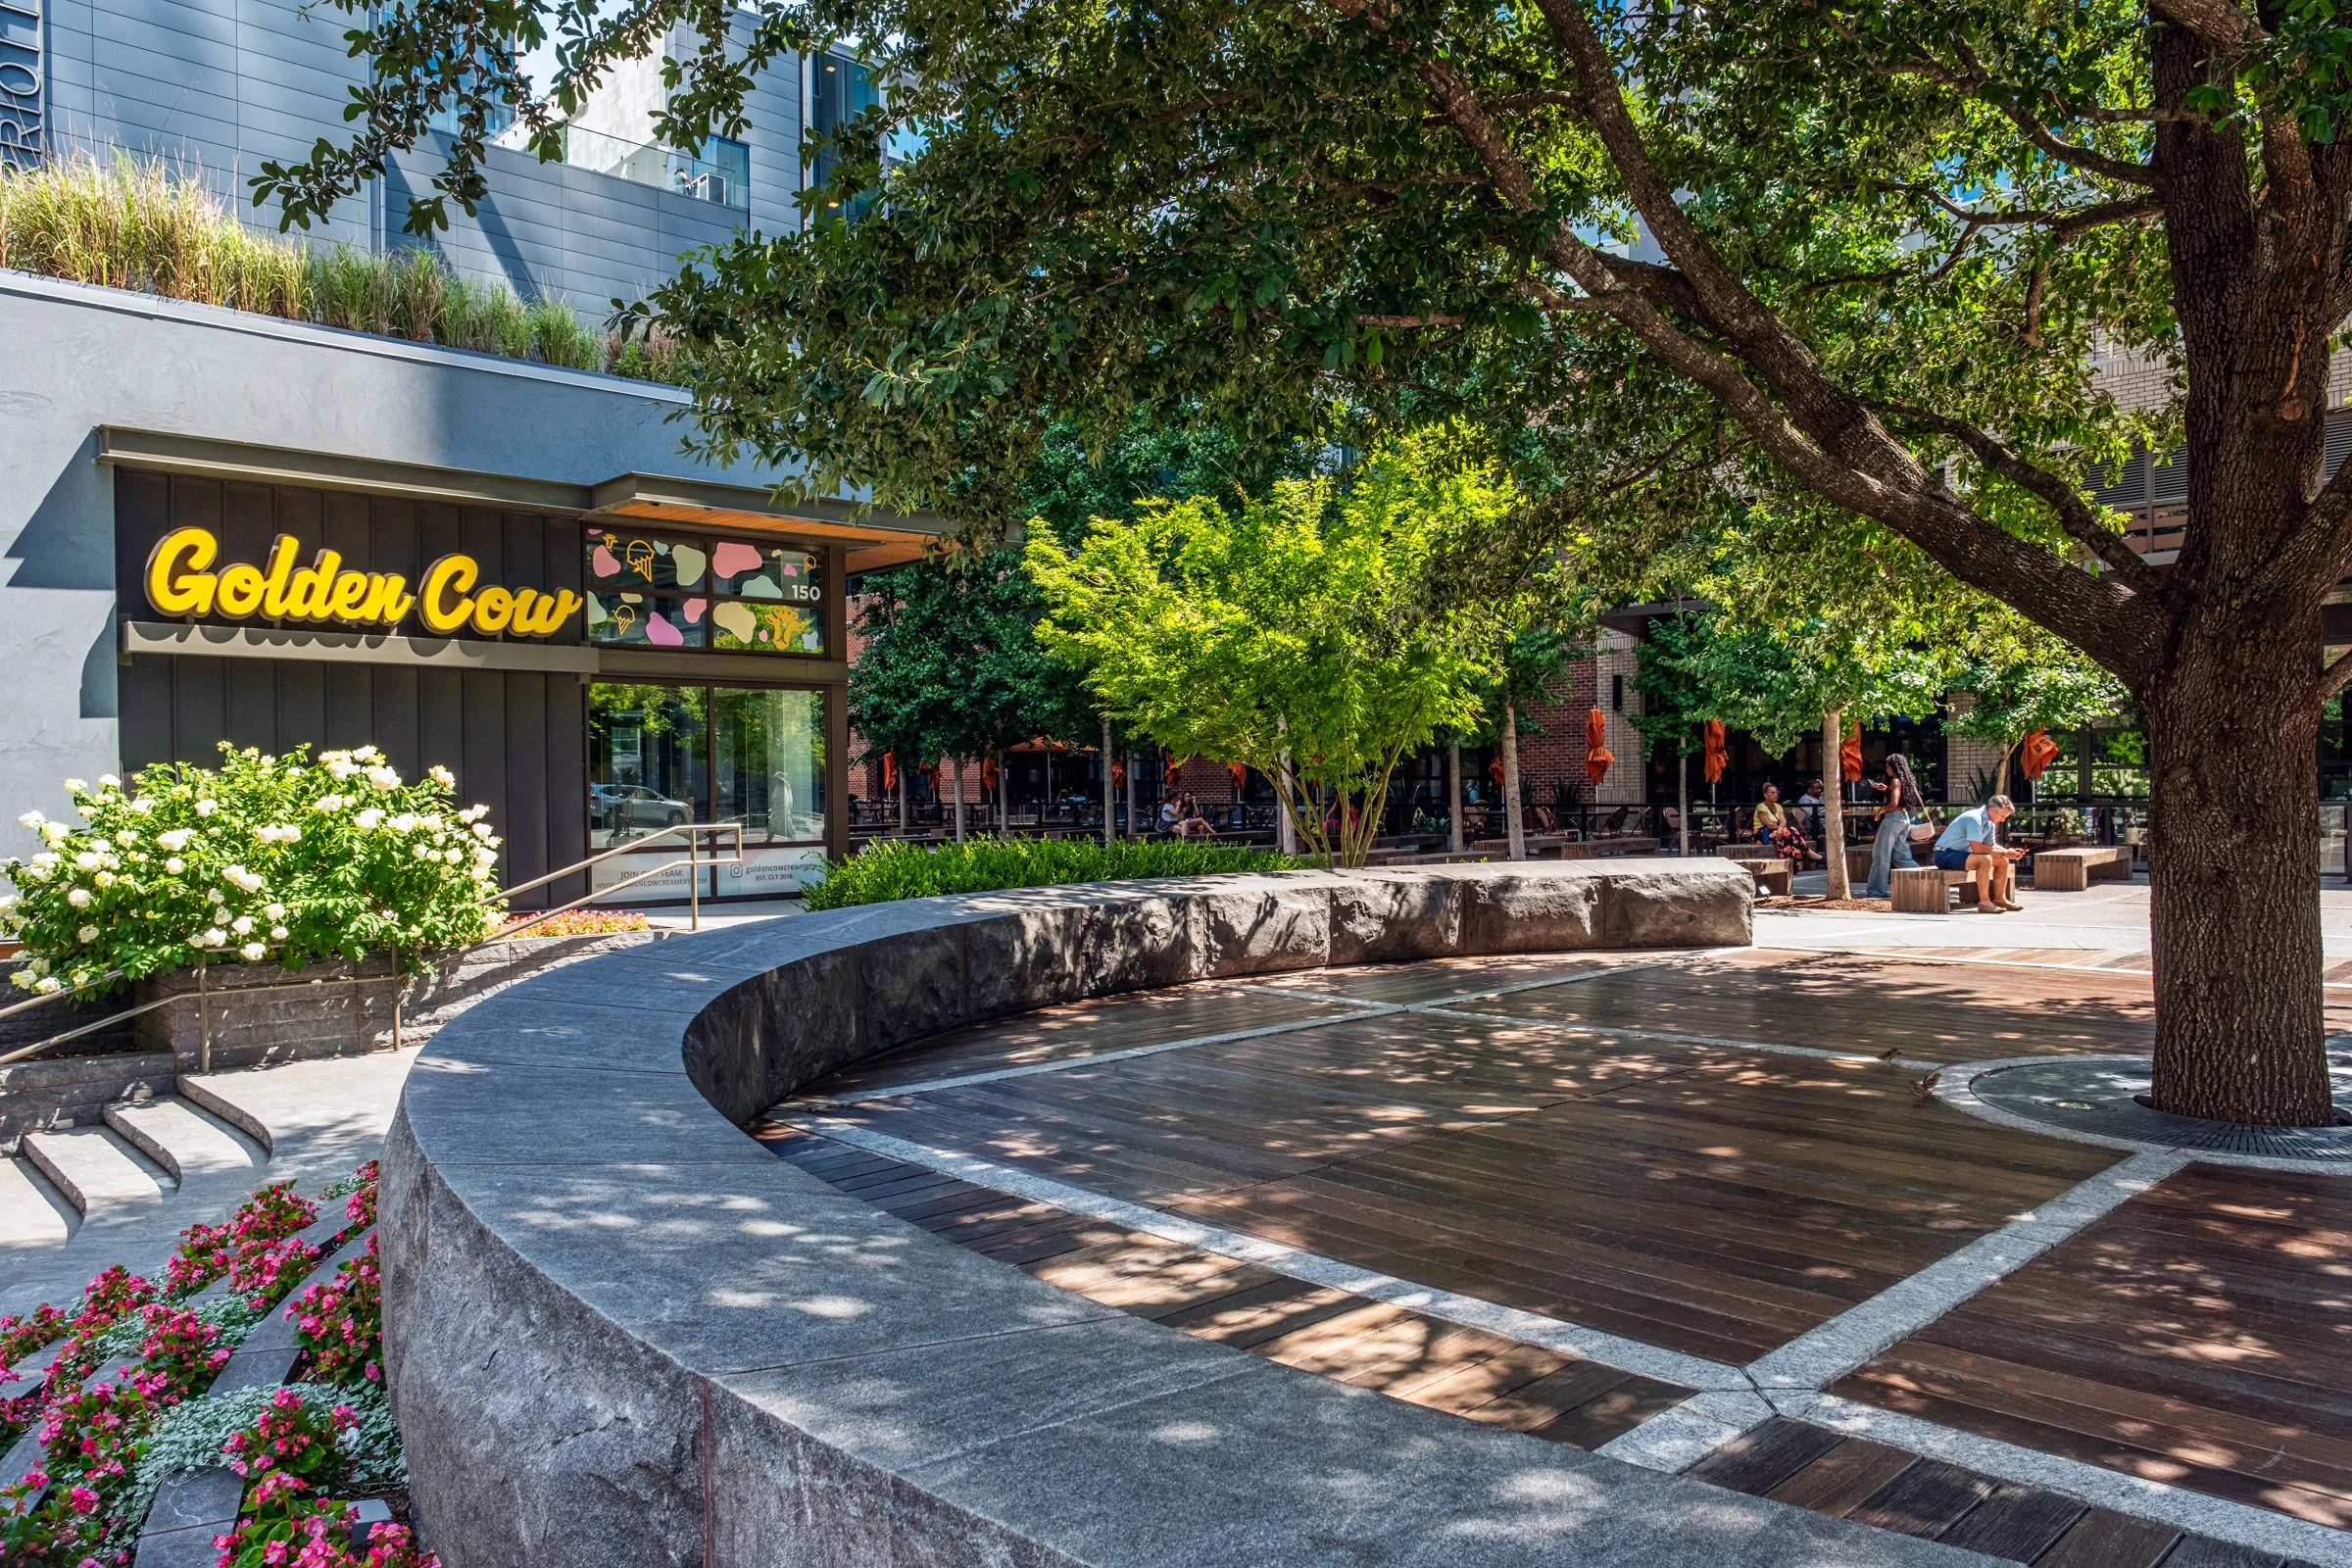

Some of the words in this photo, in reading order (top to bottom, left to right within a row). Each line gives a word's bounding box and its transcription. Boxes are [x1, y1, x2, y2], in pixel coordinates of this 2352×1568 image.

[147, 526, 414, 626] Golden
[421, 552, 584, 636] Cow
[791, 584, 821, 601] 150
[619, 870, 639, 881] JOIN
